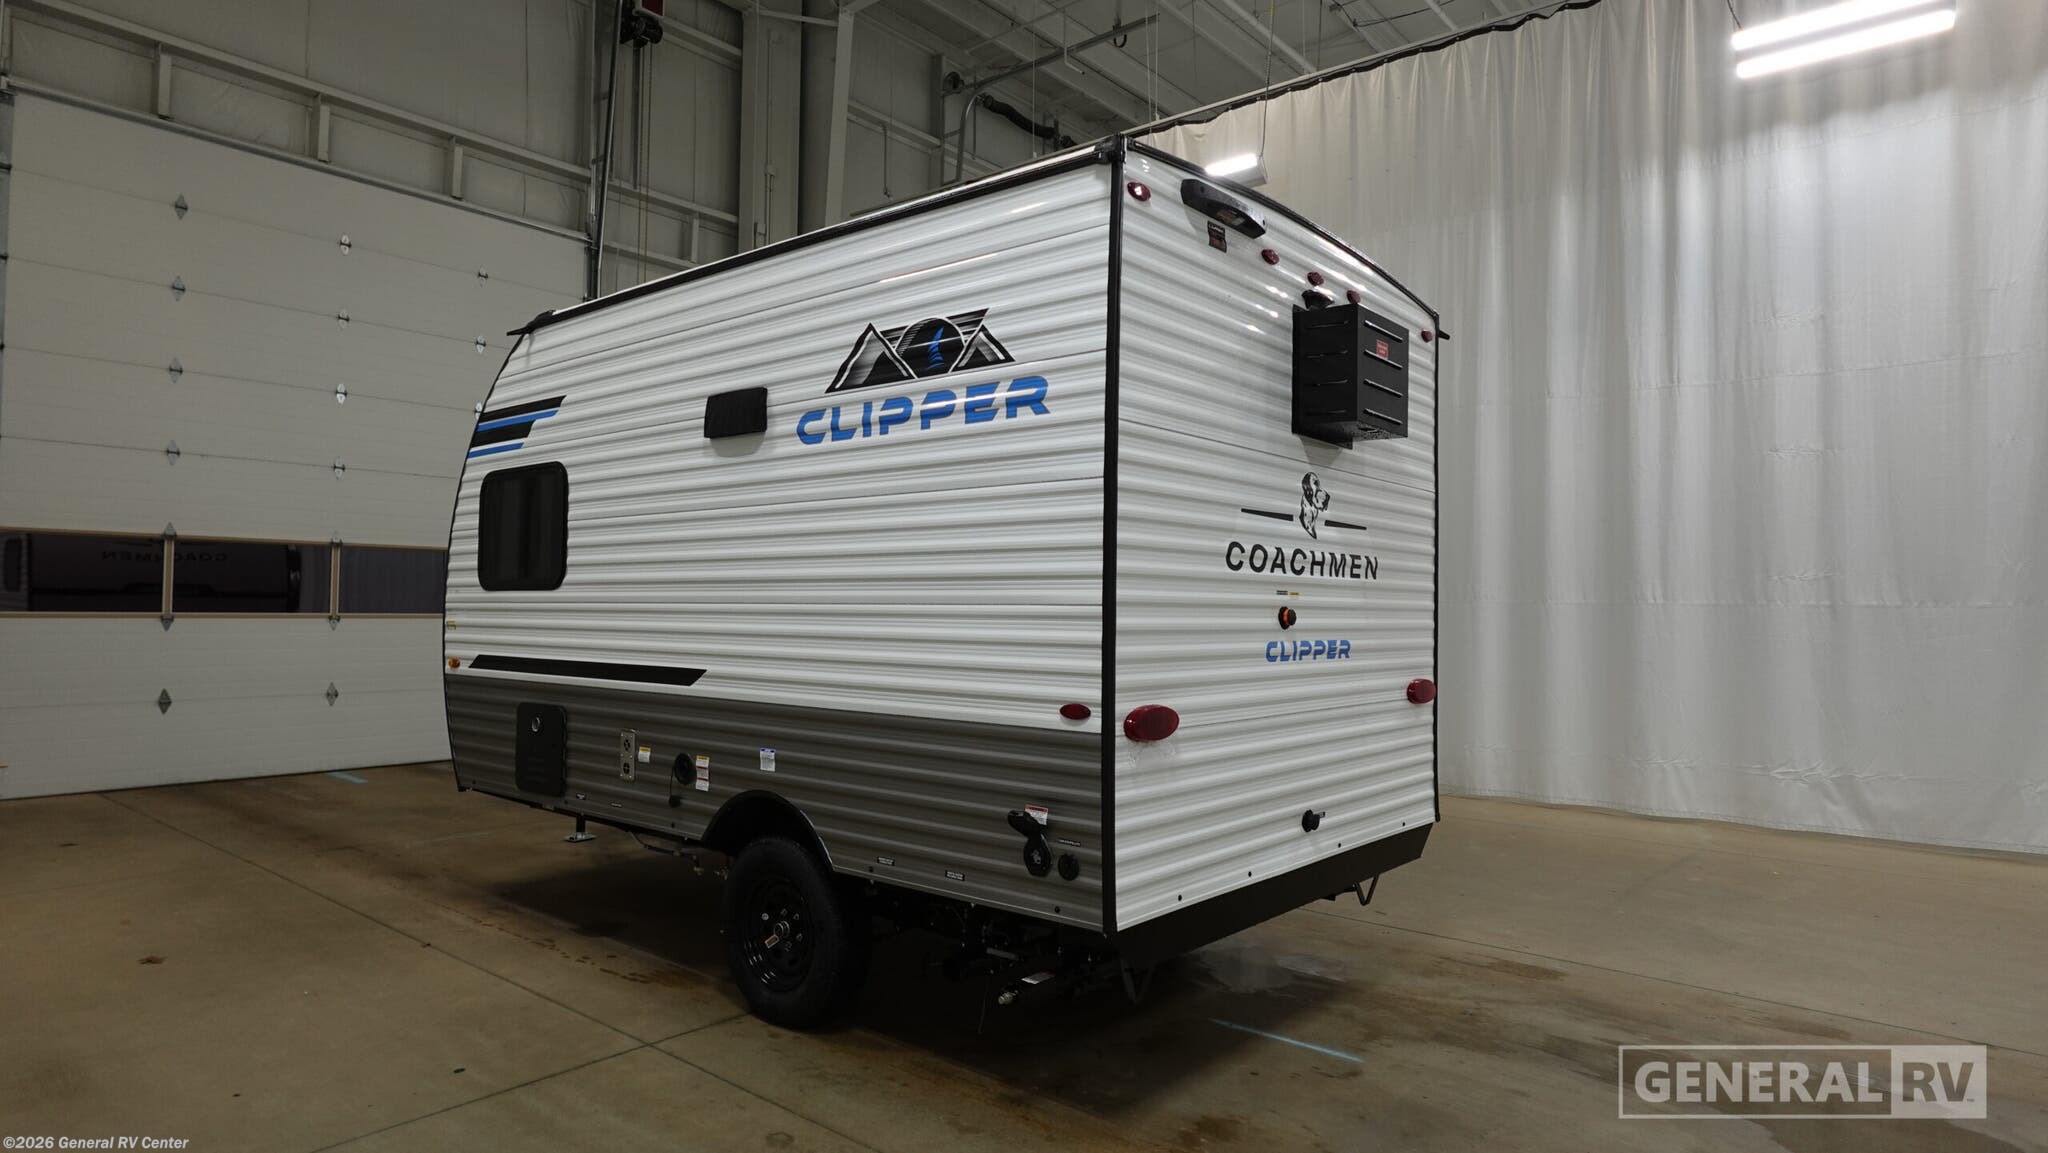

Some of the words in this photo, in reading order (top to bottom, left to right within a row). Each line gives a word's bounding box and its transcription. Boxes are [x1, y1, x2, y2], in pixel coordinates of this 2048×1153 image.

[796, 375, 1051, 445] CLIPPER
[1225, 541, 1379, 580] COACHMEN
[1265, 639, 1351, 662] CLIPPER
